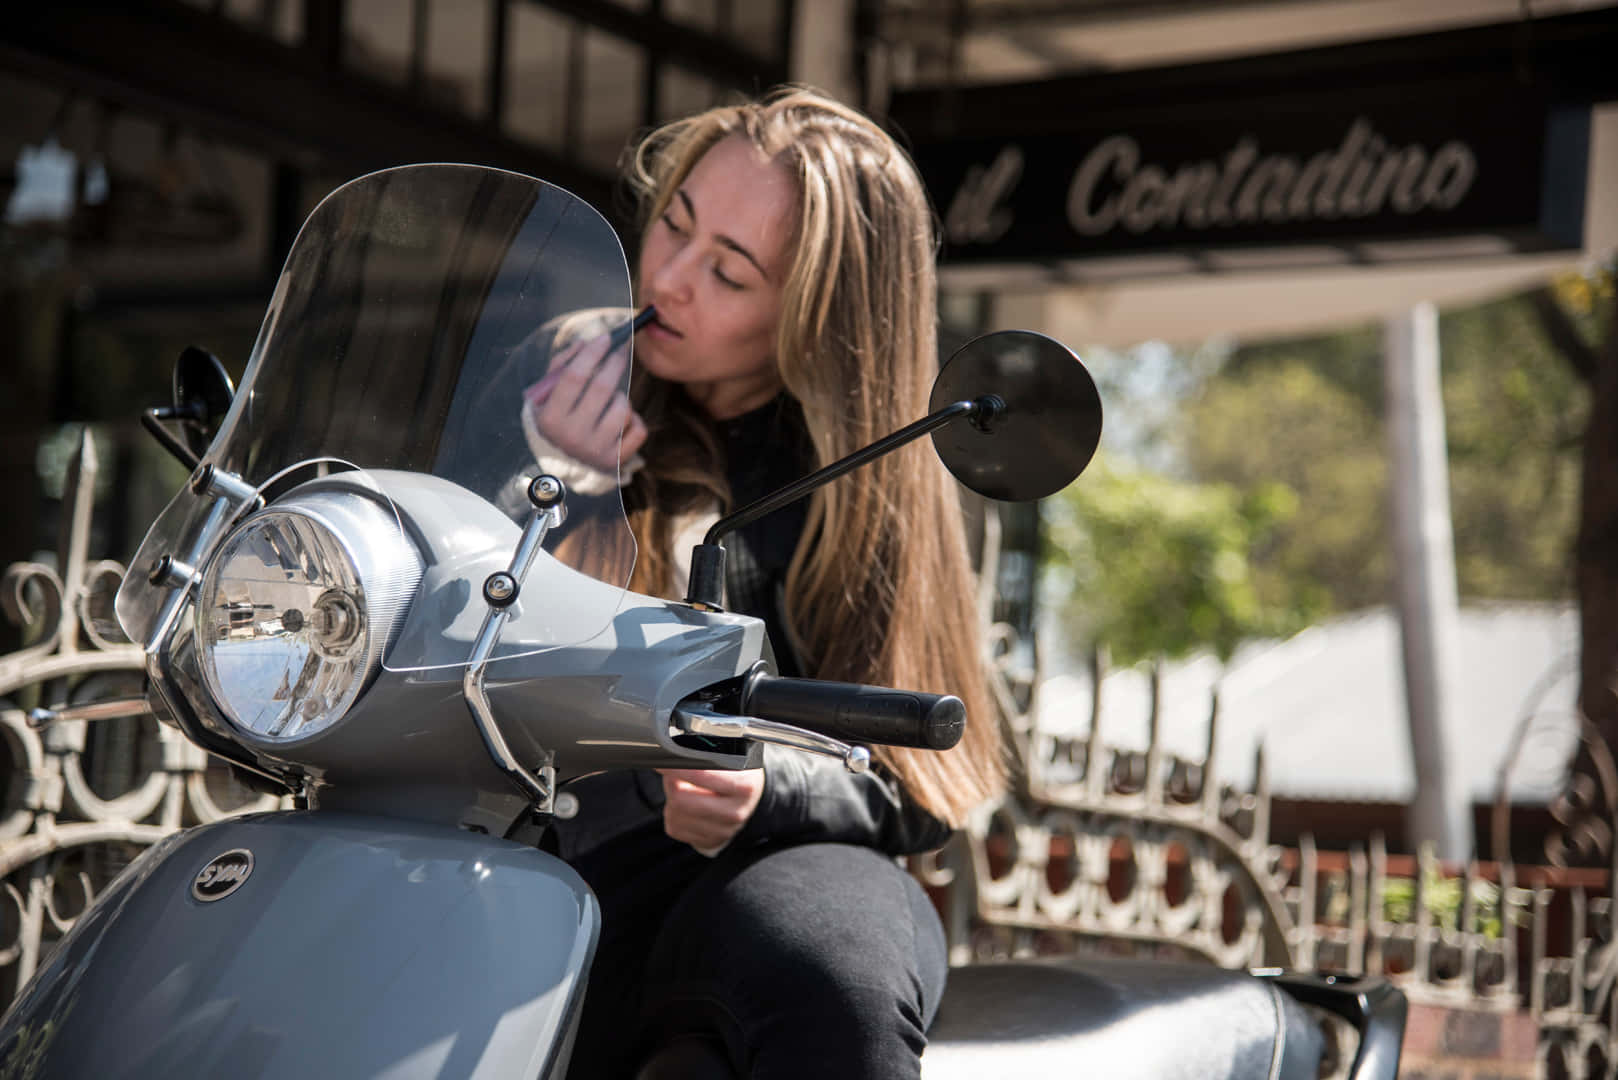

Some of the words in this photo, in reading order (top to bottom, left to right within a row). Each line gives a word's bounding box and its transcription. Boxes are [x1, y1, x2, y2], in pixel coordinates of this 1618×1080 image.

[945, 145, 1023, 243] il
[1066, 118, 1476, 235] Contadino
[197, 864, 248, 888] SYM
